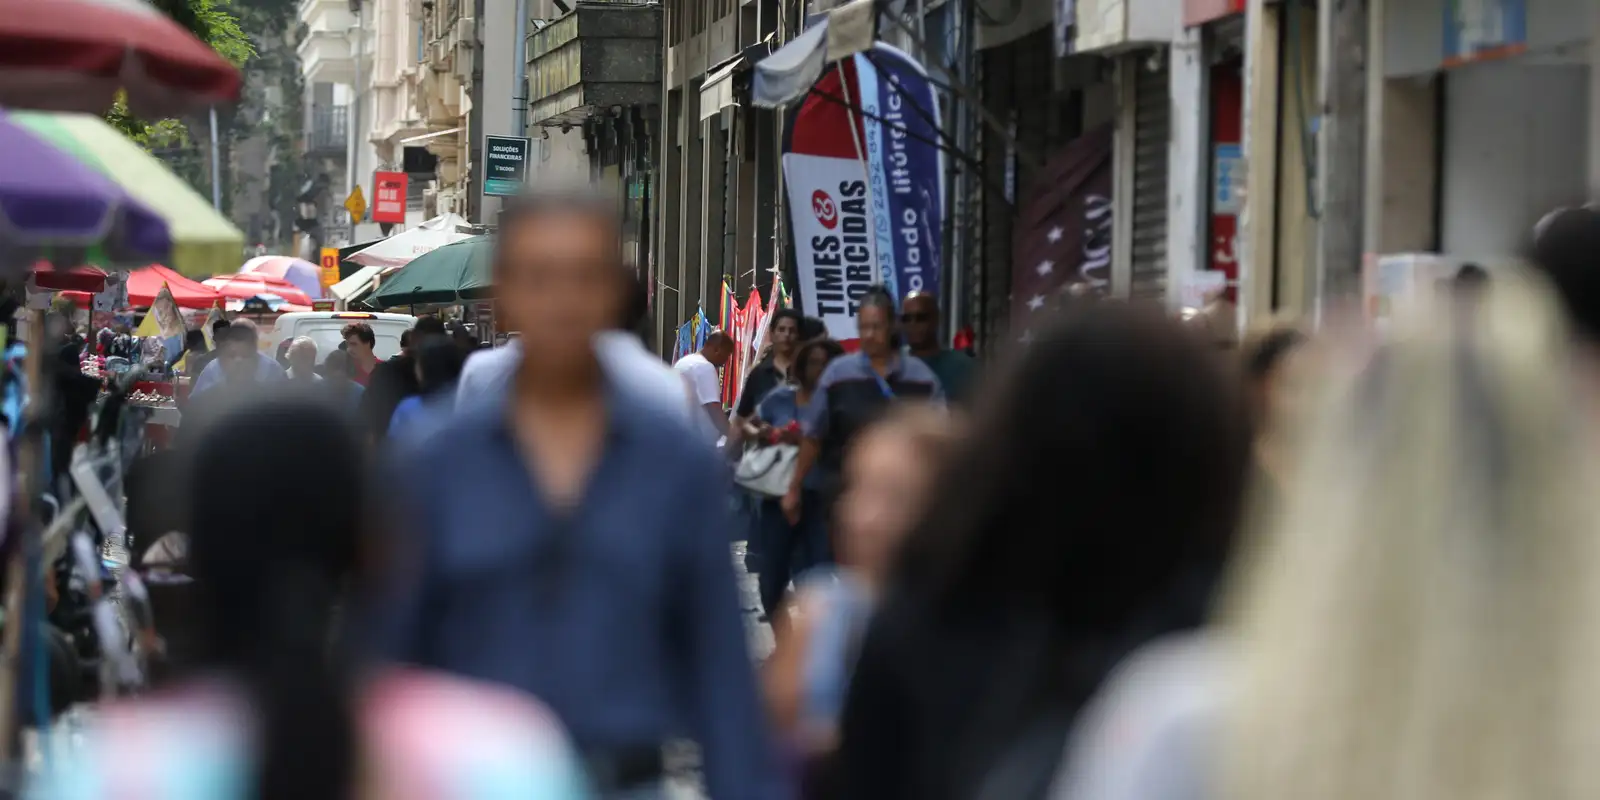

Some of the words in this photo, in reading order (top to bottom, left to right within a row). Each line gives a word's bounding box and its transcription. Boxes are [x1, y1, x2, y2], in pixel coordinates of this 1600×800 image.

[489, 153, 522, 161] FINANCEIRAS
[492, 145, 519, 153] SOLUÇÕES
[884, 73, 911, 194] litúrgico
[813, 194, 837, 223] &
[839, 180, 871, 317] TORCIDAS
[812, 235, 846, 317] TIMES
[901, 208, 924, 292] olado
